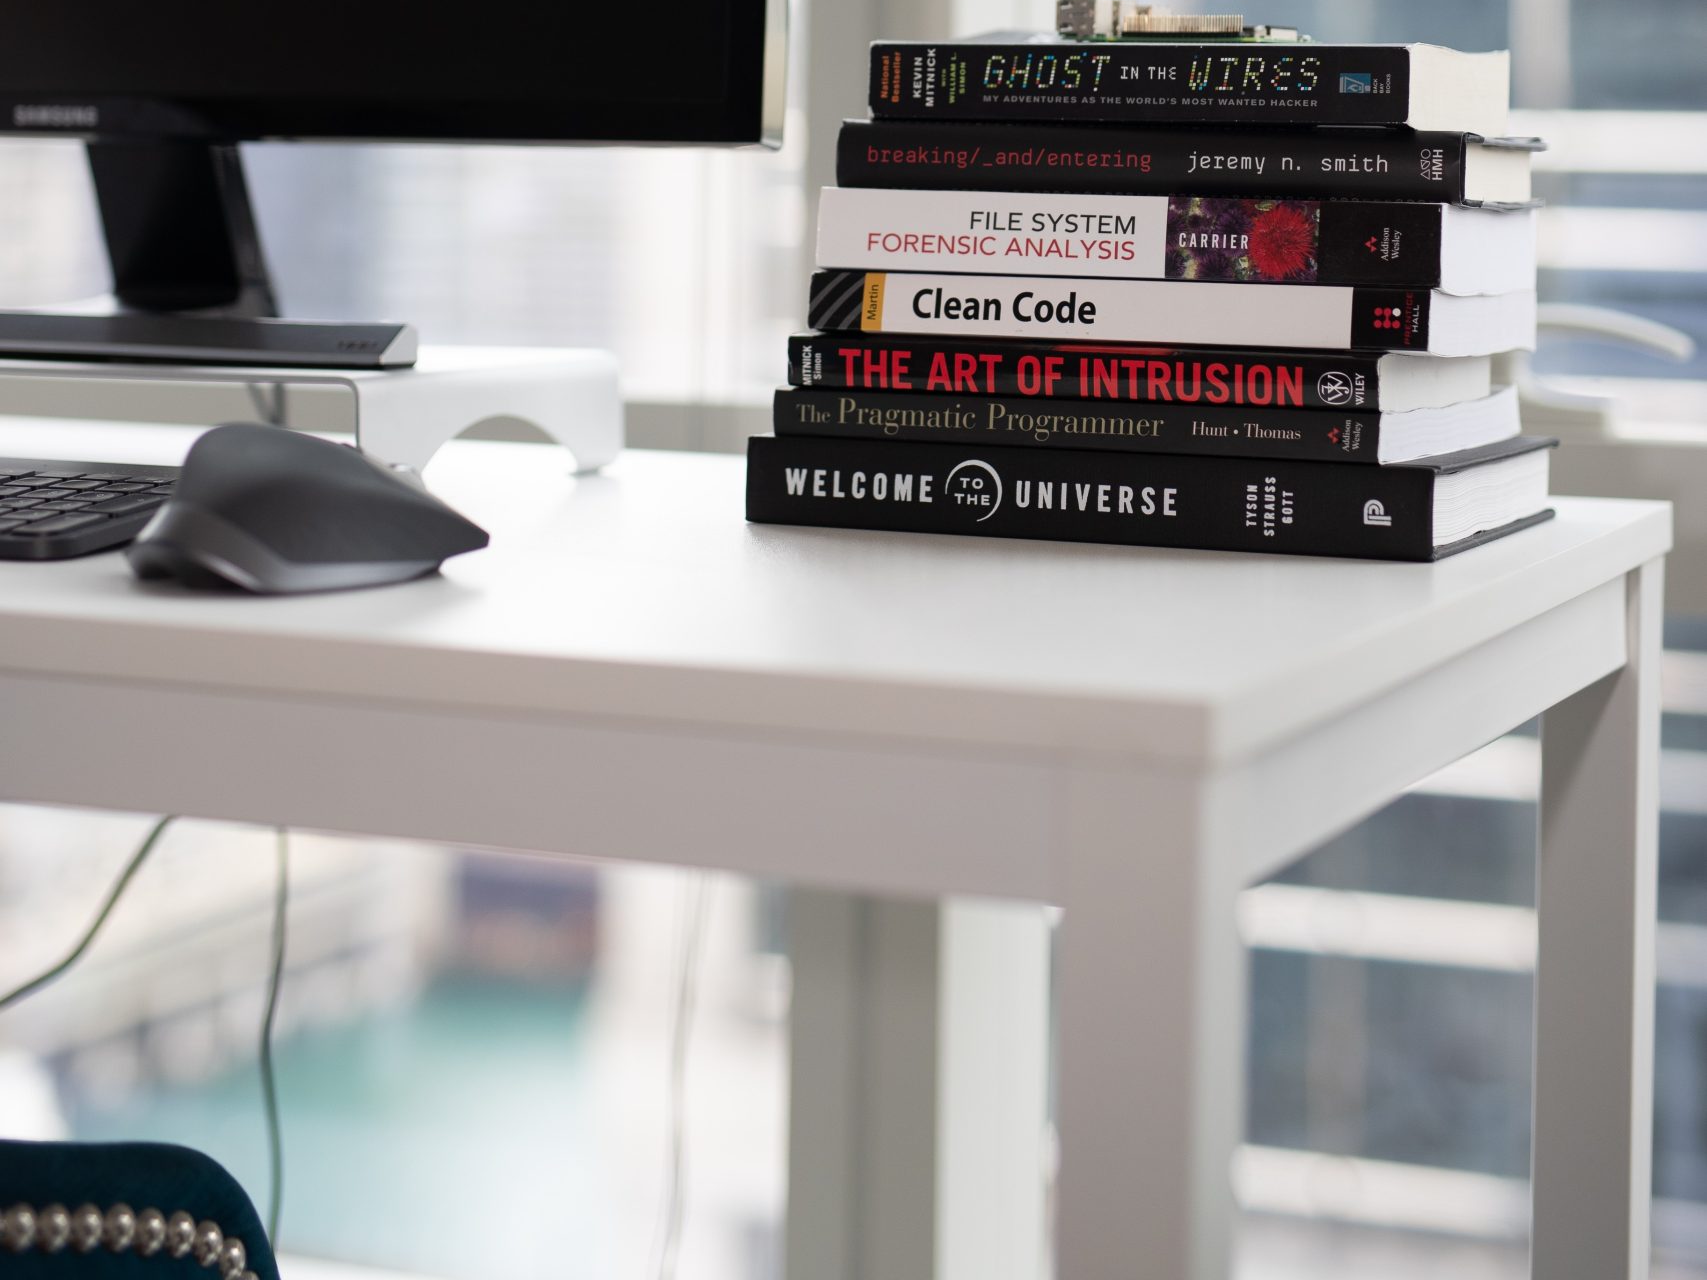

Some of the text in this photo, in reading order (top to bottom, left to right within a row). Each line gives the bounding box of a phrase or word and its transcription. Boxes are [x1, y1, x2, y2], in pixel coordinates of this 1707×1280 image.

[880, 55, 889, 98] National
[891, 51, 901, 102] Bestseller
[913, 56, 923, 98] KEVIN
[925, 48, 936, 107] MITNICK
[949, 63, 957, 103] WILLIAM
[959, 62, 967, 94] SIMON
[983, 52, 1321, 95] GHOST IN THE WIRES
[983, 95, 1318, 107] MY ADVENTURES AS THE WORLD'S MOST WANTED HACKER
[1188, 151, 1389, 174] jeremy n. smith
[1432, 149, 1443, 181] HMH
[970, 211, 1136, 235] FILE SYSTEM
[868, 233, 1136, 260] FORENSIC ANALYSIS
[1178, 232, 1249, 249] CARRIER
[1381, 227, 1390, 261] Addison
[1392, 229, 1402, 259] Wesley
[867, 284, 879, 320] Martin
[912, 288, 1096, 324] Clean Code
[1412, 305, 1420, 332] HALL
[802, 345, 812, 386] MITNICK
[813, 352, 822, 380] Simon
[838, 348, 1304, 407] THE ART OF INTRUSION
[1355, 373, 1365, 405] WILEY
[796, 397, 1164, 442] The Pragmatic Programmer
[1192, 421, 1302, 440] Hunt Thomas
[1342, 420, 1352, 451] Addison
[1352, 422, 1363, 450] Wesley
[785, 468, 1177, 516] WELCOME TO THE UNIVERSE
[1246, 484, 1258, 527] TYSON
[1264, 476, 1276, 536] STRAUSS
[1282, 490, 1294, 524] GOTT
